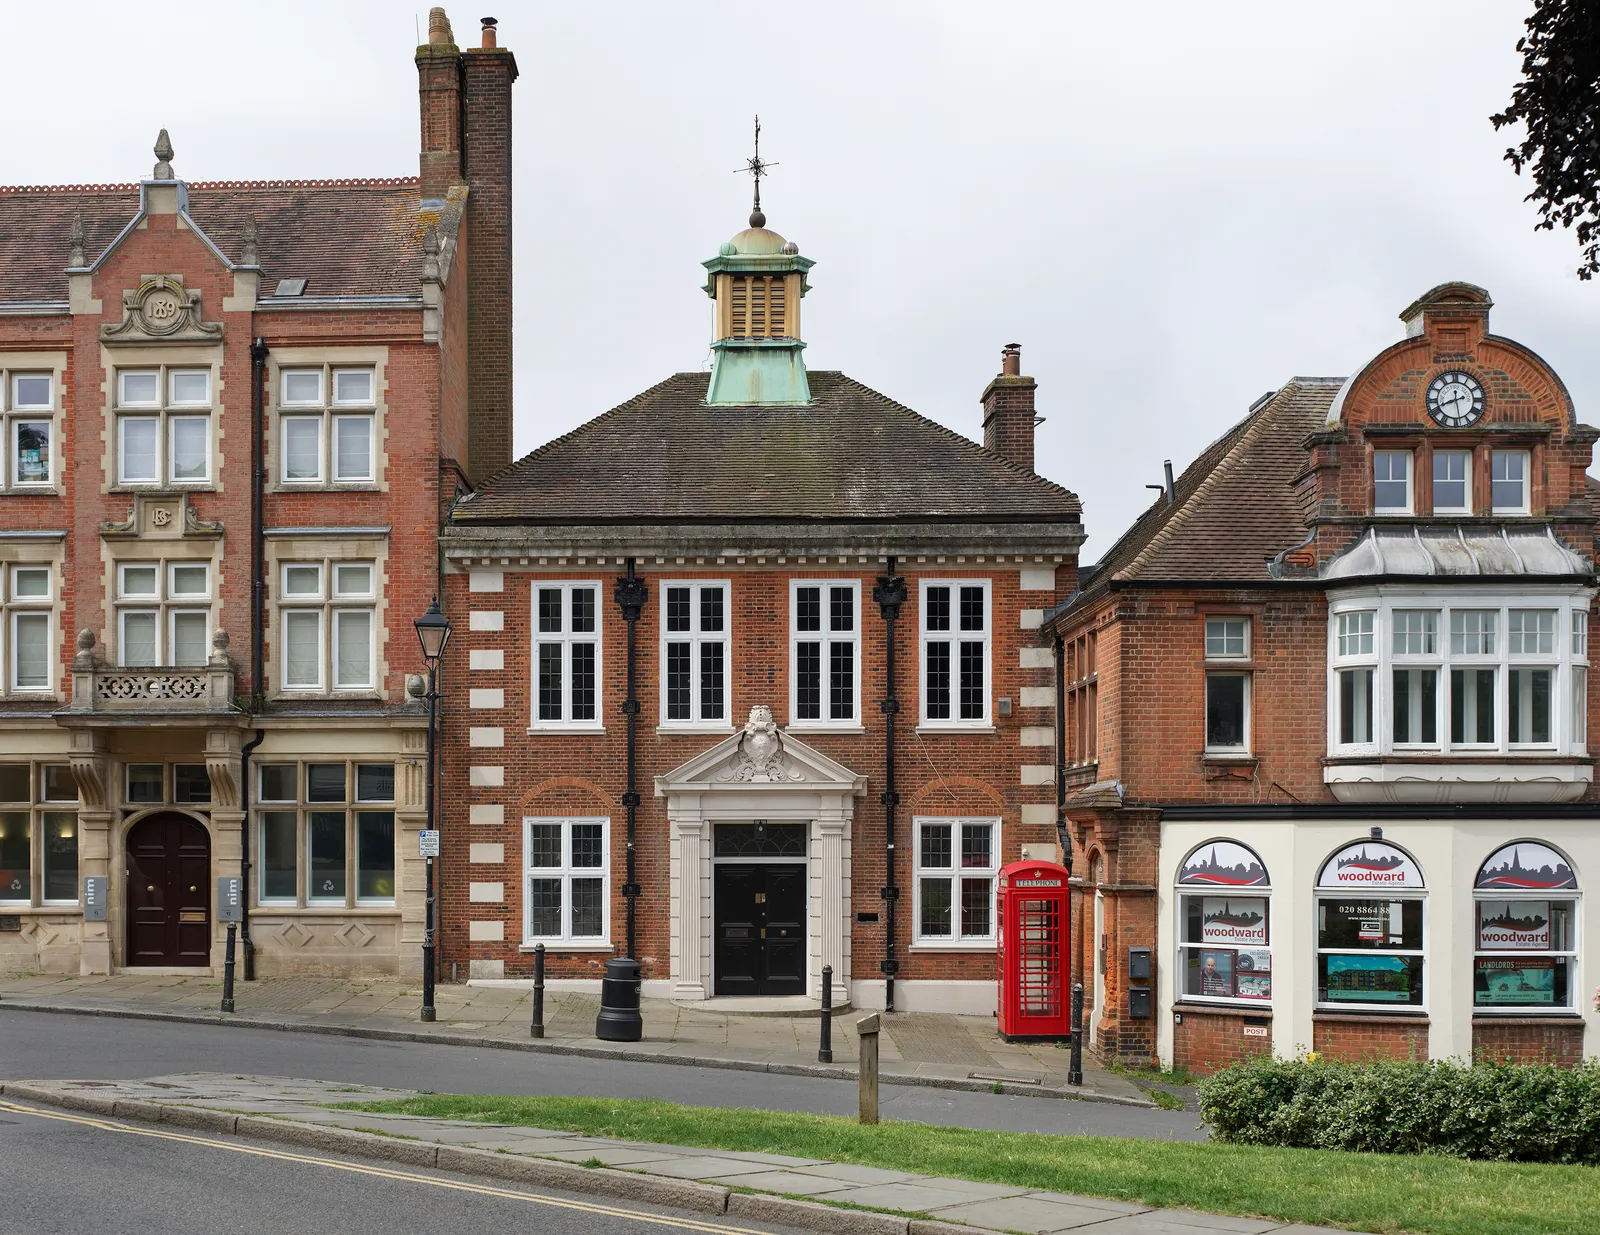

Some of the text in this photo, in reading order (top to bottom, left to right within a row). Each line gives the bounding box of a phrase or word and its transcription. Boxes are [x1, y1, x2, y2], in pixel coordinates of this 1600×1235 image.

[1337, 871, 1405, 881] woodward
[85, 879, 94, 905] nim
[227, 879, 237, 905] nim
[1357, 906, 1378, 914] 8864
[1204, 927, 1264, 938] woodward
[1481, 932, 1548, 942] woodward
[1480, 961, 1515, 969] LANDLORDS
